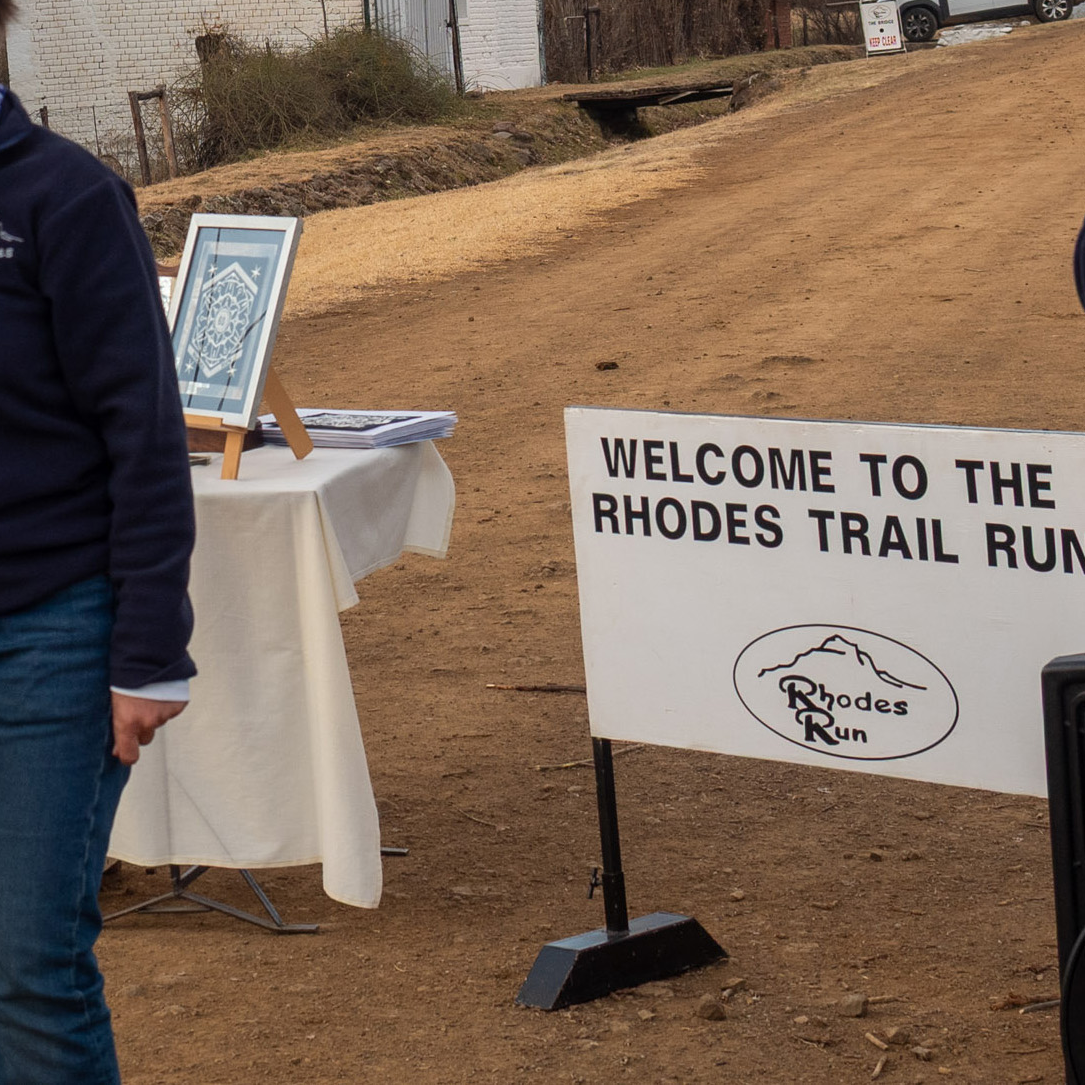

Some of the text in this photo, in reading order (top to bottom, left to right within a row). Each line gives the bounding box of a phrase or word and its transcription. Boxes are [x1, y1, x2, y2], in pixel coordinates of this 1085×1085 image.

[869, 35, 897, 47] KEEP CLEAR
[600, 436, 1056, 510] WELCOME TO THE
[592, 492, 784, 548] RHODES
[807, 508, 960, 564] TRAIL
[778, 674, 909, 716] Rhodes
[795, 708, 868, 746] Run
